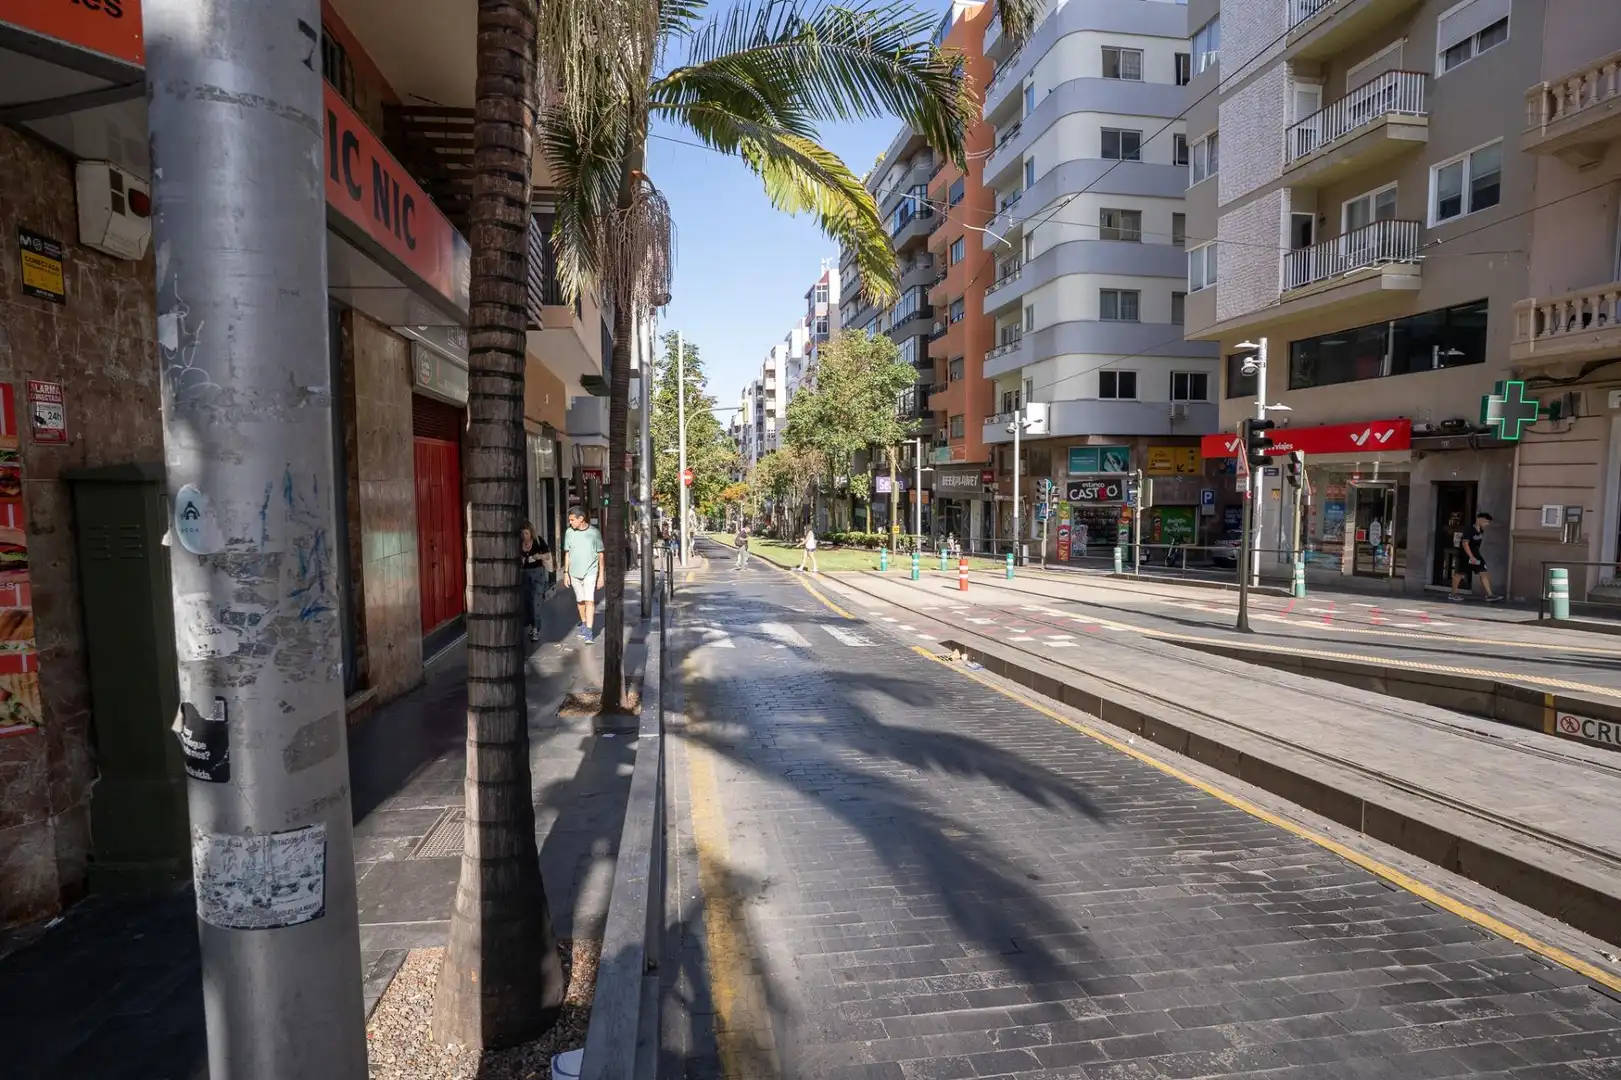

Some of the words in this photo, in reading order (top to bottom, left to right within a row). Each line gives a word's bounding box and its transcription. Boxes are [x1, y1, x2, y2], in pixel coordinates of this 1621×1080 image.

[328, 108, 362, 201] IC
[371, 155, 416, 251] NIC
[48, 411, 62, 421] 24h
[1204, 492, 1213, 503] P
[0, 582, 15, 591] ES
